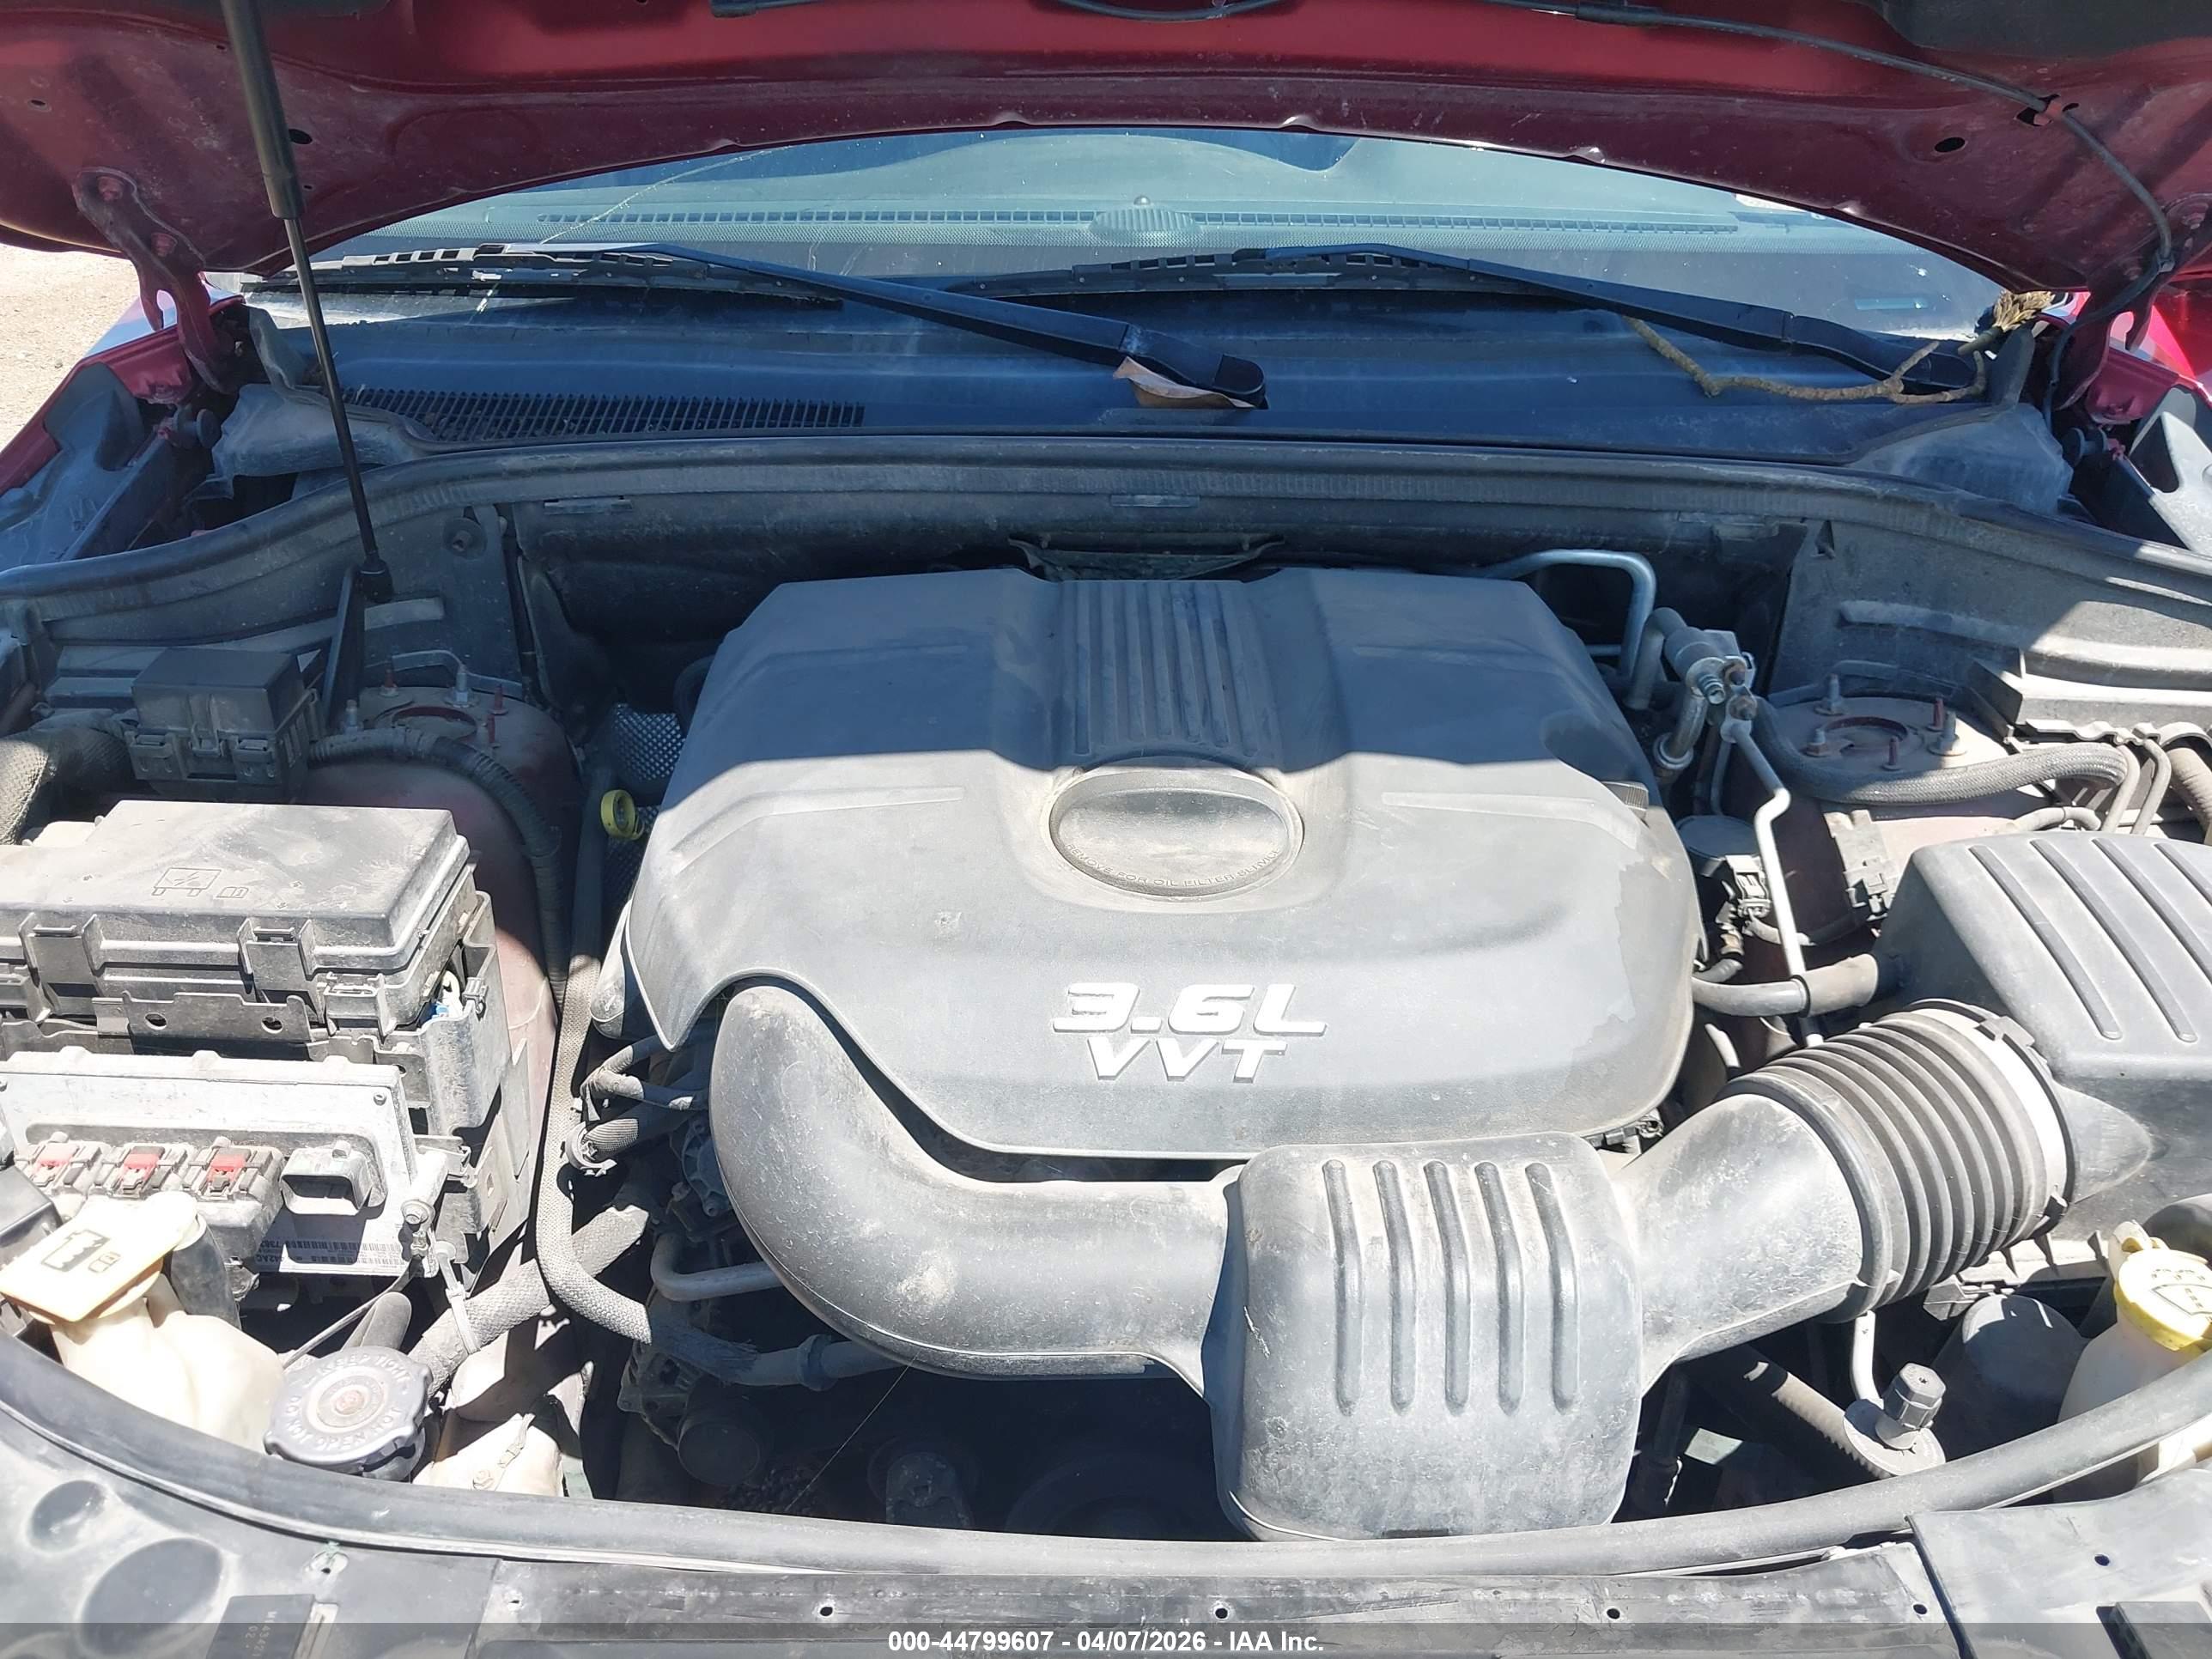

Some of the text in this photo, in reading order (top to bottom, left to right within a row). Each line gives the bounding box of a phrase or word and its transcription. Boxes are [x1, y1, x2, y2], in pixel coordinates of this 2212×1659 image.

[1066, 843, 1280, 887] REMOVE FOR OIL FILTER SERVICE
[1052, 981, 1328, 1036] 3.6L
[1087, 1036, 1288, 1084] VVT
[316, 1353, 410, 1382] KEEP TIGHT
[286, 1395, 402, 1451] DO NOT OPEN HOT
